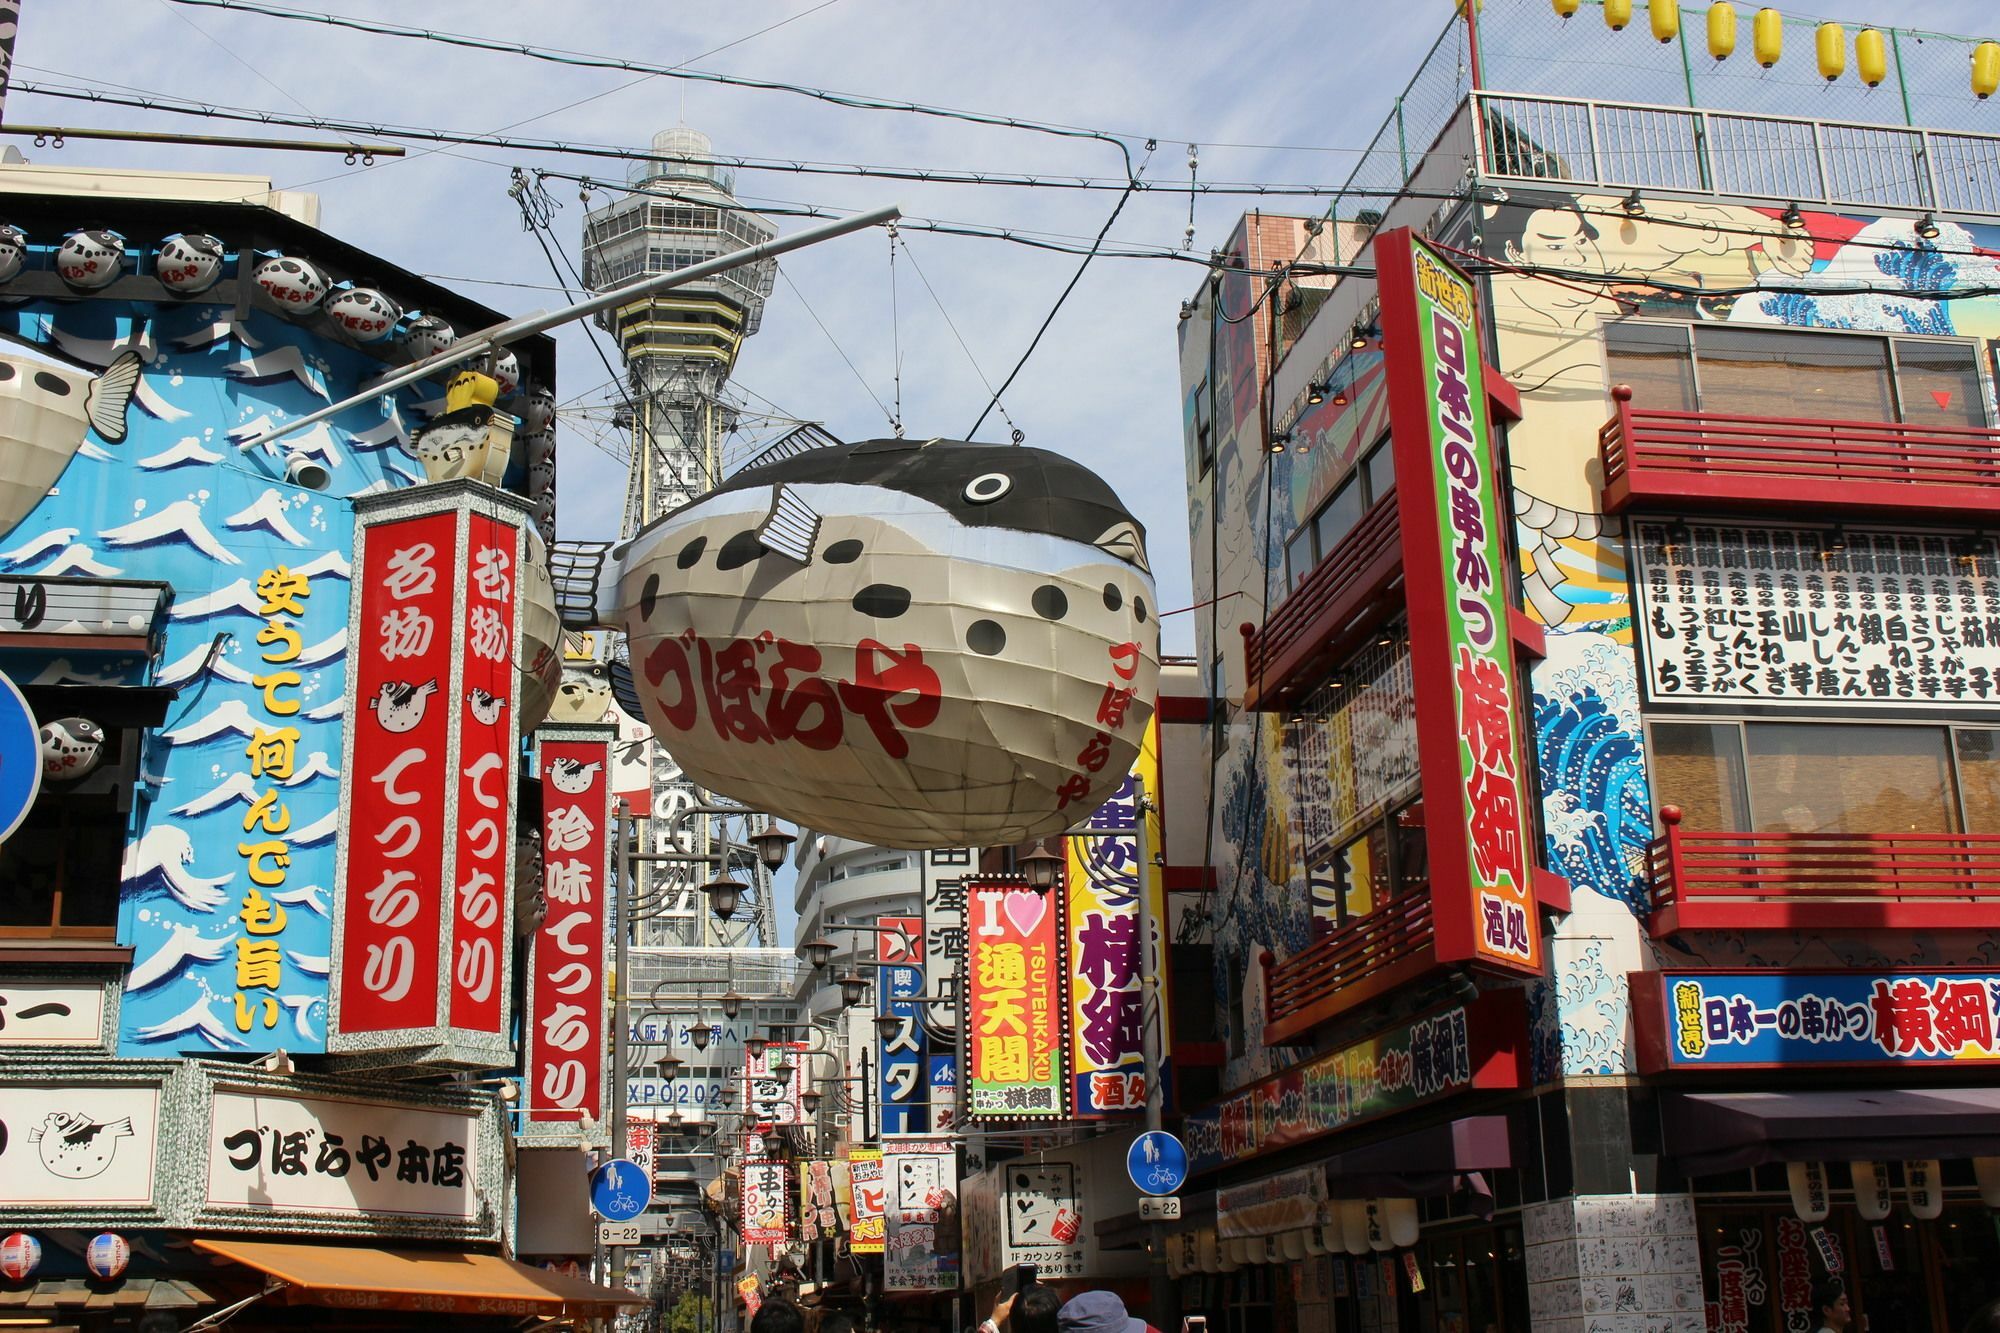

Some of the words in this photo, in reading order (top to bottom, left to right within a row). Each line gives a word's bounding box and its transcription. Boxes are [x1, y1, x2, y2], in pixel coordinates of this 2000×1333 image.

[1416, 252, 1471, 329] 新世界
[1432, 312, 1495, 646] 日本一の串かつ
[15, 583, 46, 630] り
[380, 542, 437, 662] 名物
[470, 544, 509, 663] 名物
[1651, 607, 1681, 691] もち
[1679, 607, 1709, 692] うずら玉子
[1704, 609, 1736, 692] 紅しょうが
[1729, 610, 1759, 693] にんにく
[1757, 611, 1788, 694] 玉ねぎ
[1783, 612, 1813, 694] 山芋
[1808, 613, 1839, 695] しし唐
[1834, 613, 1866, 696] れんこん
[1859, 614, 1889, 696] 銀杏
[1886, 615, 1916, 697] 白ねぎ
[1912, 615, 1942, 697] さつま芋
[1935, 615, 1967, 697] じゃが芋
[1960, 617, 1992, 697] 茄子
[644, 628, 941, 759] づぼらや
[1057, 641, 1144, 810] づぼらや
[233, 564, 311, 1032] 安うて何んでも旨い
[1457, 646, 1526, 896] 横綱
[654, 744, 697, 917] の日立
[977, 892, 1005, 936] I
[1485, 896, 1530, 956] 酒処
[540, 805, 595, 1110] 珍味てっちり
[894, 969, 912, 1008] 喫茶
[977, 942, 1030, 1083] 通天閣
[1677, 984, 1704, 1055] 新世界
[1705, 996, 1869, 1040] 日本一の串かつ
[1872, 981, 1993, 1053] 横綱
[886, 1015, 919, 1134] スター
[935, 1064, 957, 1082] As
[975, 1090, 1004, 1099] 日本一の
[975, 1099, 1004, 1109] 串かつ
[1005, 1086, 1052, 1110] 横綱
[223, 1126, 467, 1188] づぼらや本店
[626, 1127, 650, 1170] 串か
[853, 1162, 877, 1172] 新世界
[758, 1167, 782, 1222] 串かつ
